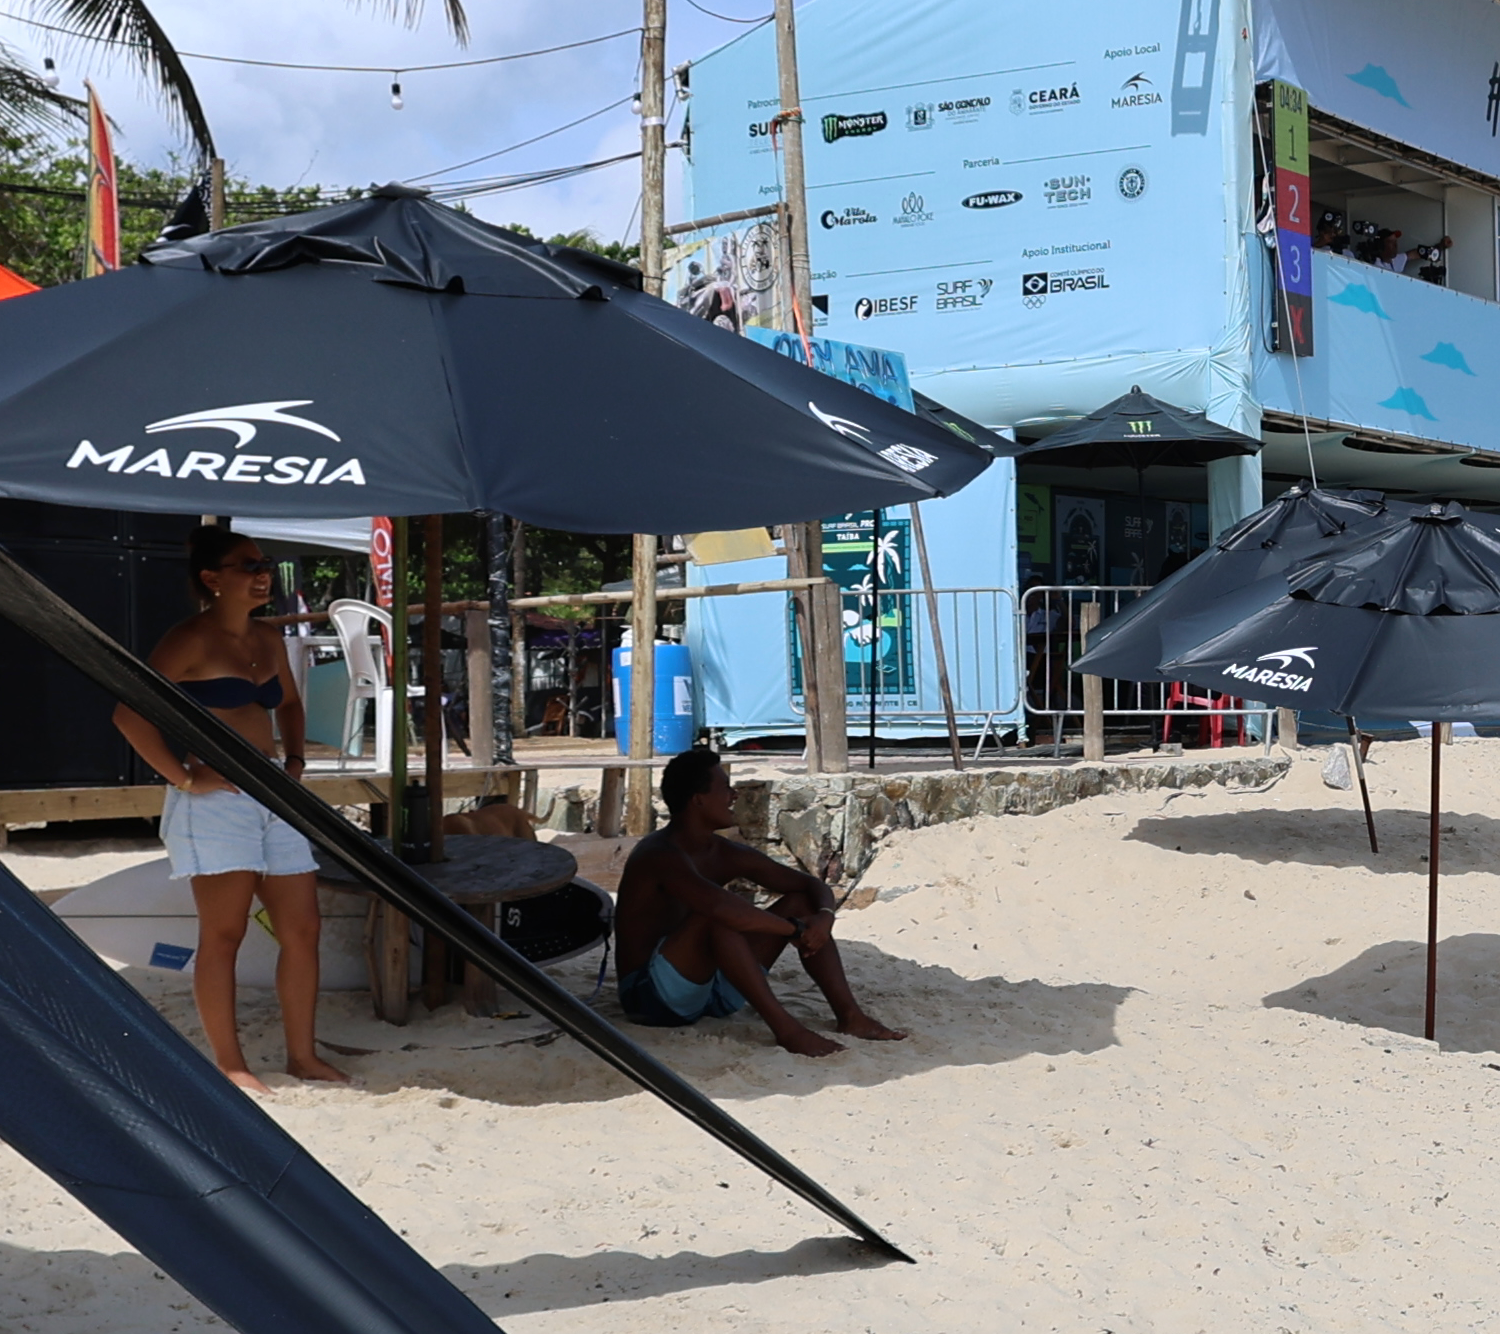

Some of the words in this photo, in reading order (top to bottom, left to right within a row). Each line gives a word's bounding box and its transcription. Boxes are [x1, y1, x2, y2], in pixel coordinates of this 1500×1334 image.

[1103, 47, 1132, 60] Apoio
[1134, 43, 1161, 54] Local
[1029, 82, 1080, 103] CEARÁ
[1111, 93, 1163, 109] MARESIA
[1279, 84, 1302, 114] 04:34
[838, 113, 884, 131] MONSTER
[1289, 125, 1297, 161] 1
[963, 156, 1000, 168] Parceria
[1043, 187, 1091, 204] TECH
[1288, 184, 1300, 223] 2
[1022, 247, 1049, 259] Apoio
[1050, 240, 1111, 255] Institucional
[1291, 245, 1301, 283] 3
[937, 280, 972, 296] SURF
[1050, 275, 1110, 293] BRASIL
[874, 296, 918, 313] IBESF
[936, 295, 983, 310] BRASIL
[66, 440, 366, 485] MARESIA
[1222, 663, 1314, 692] MARESIA
